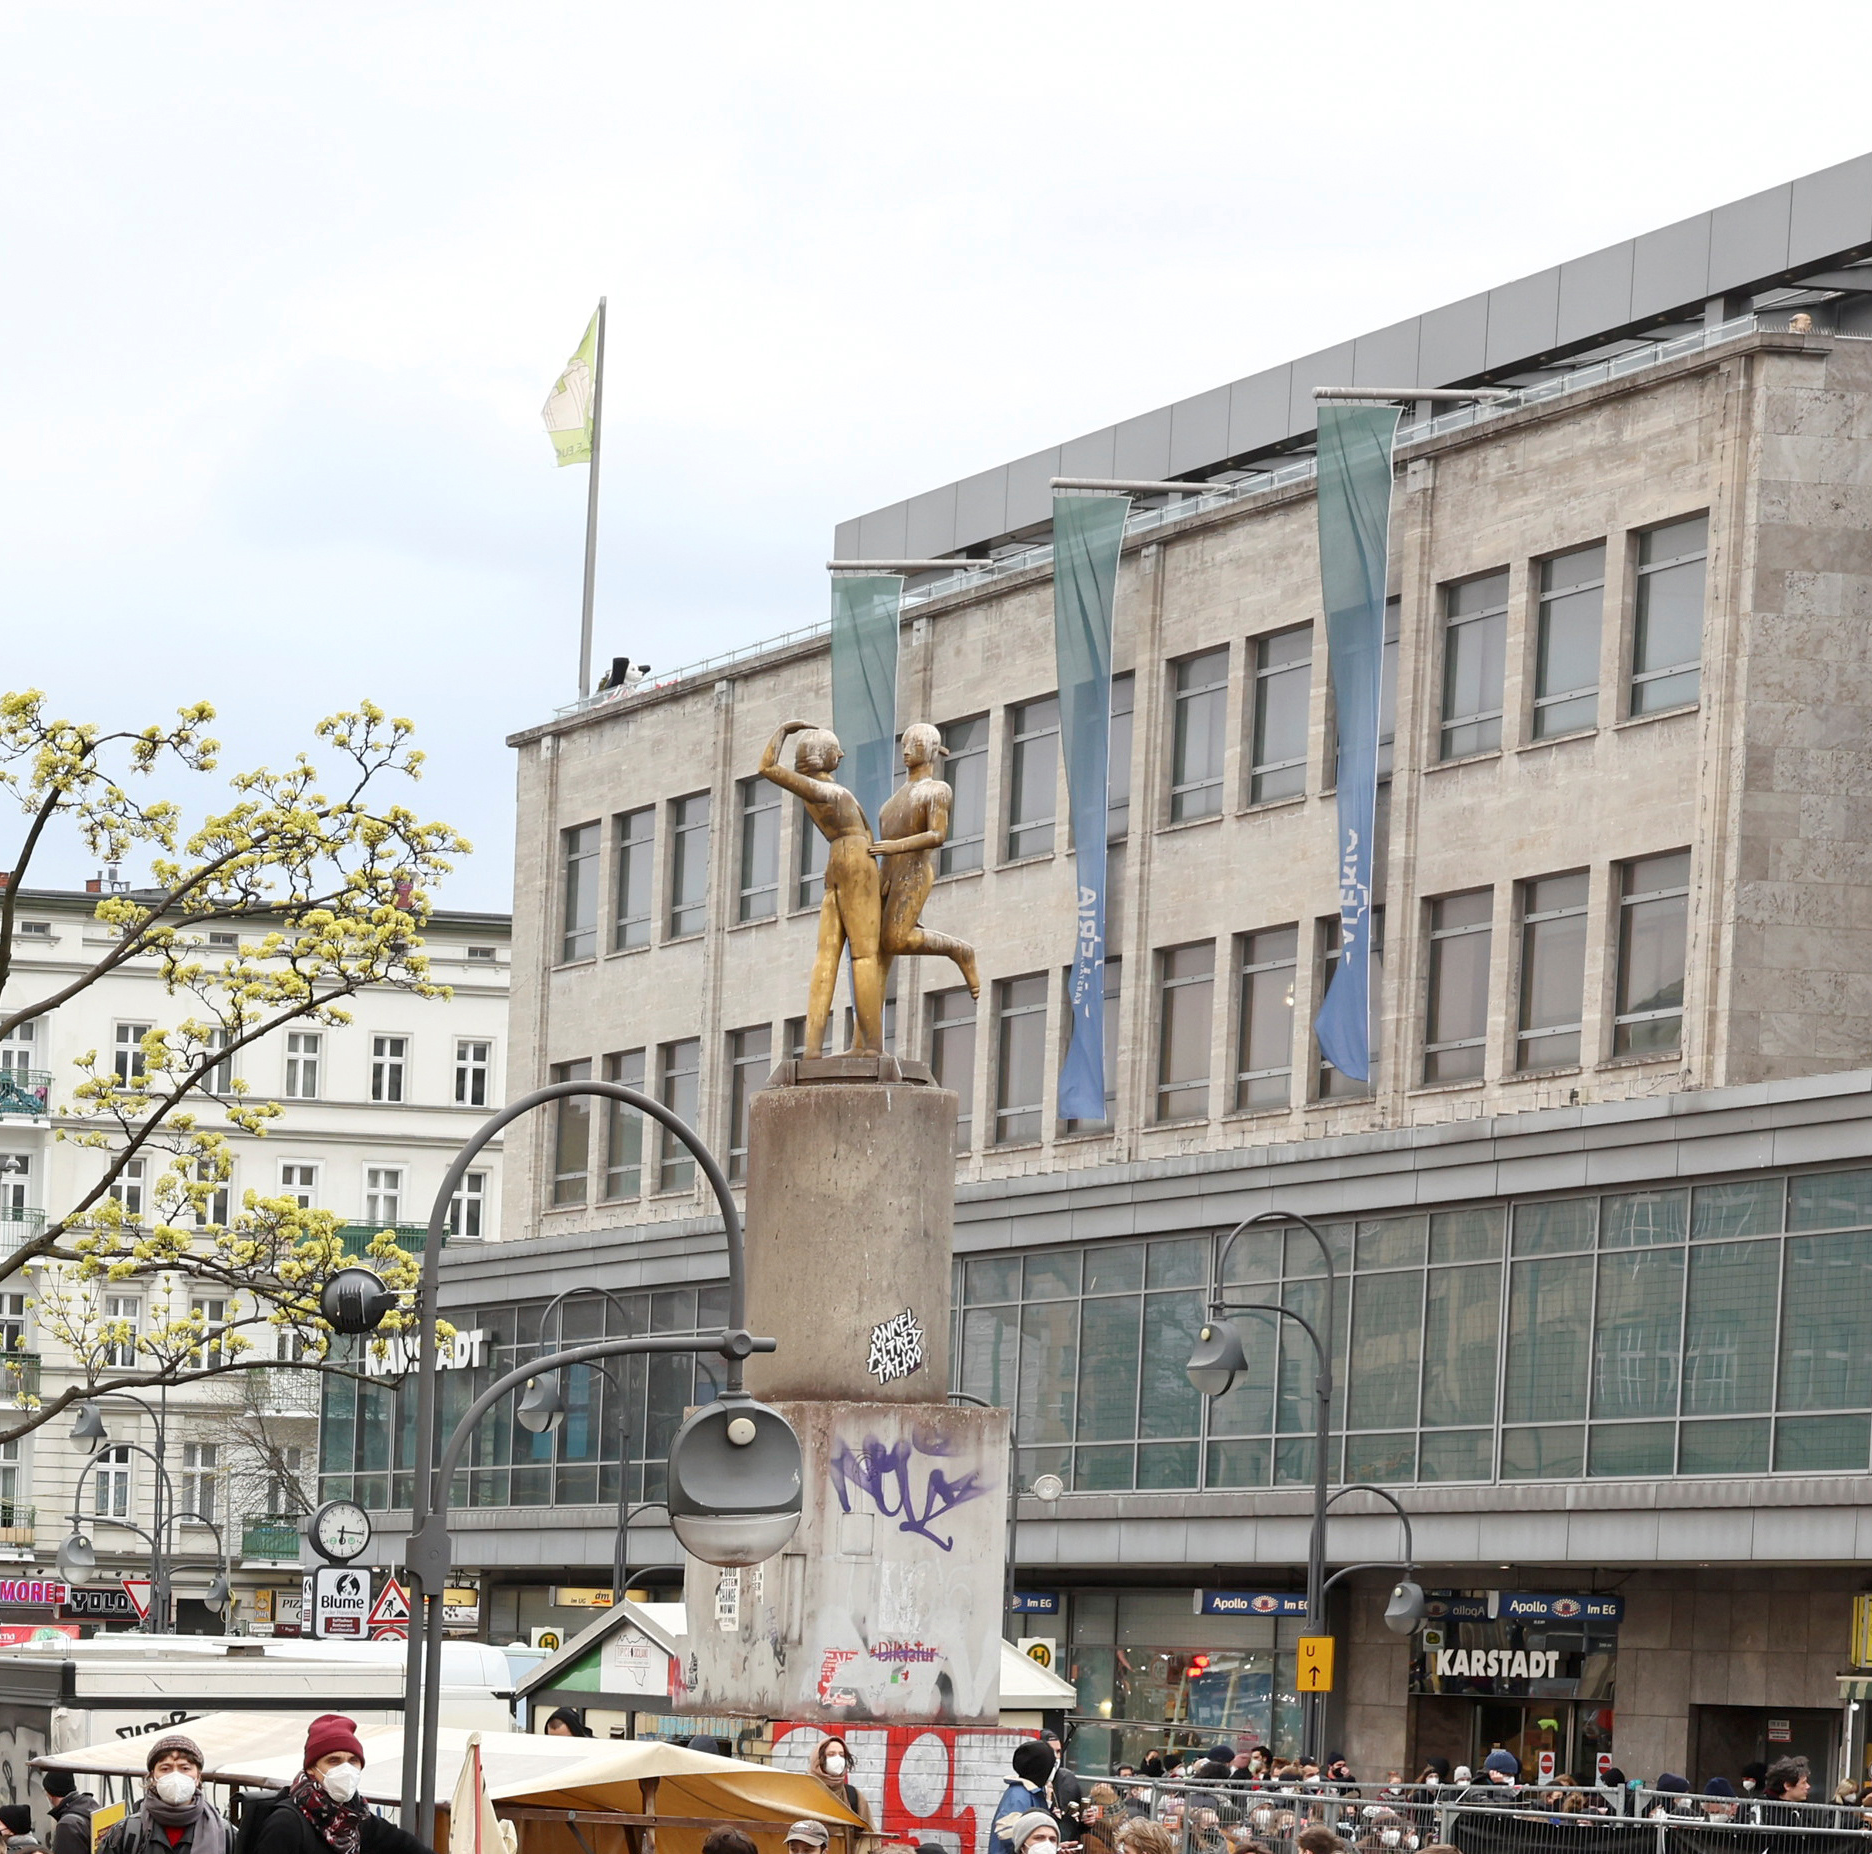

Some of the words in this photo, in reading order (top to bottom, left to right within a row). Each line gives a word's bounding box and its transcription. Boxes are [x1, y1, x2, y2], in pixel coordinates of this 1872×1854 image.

[871, 1307, 918, 1340] ONKEL
[365, 1329, 483, 1377] KARSADT
[320, 1594, 365, 1610] Blume
[595, 1590, 610, 1600] dm
[718, 1604, 737, 1614] NOW!
[1026, 1598, 1039, 1608] Im
[1039, 1599, 1053, 1609] EG
[1213, 1596, 1248, 1611] Apollo
[1284, 1599, 1296, 1610] Im
[1509, 1599, 1548, 1613] Apollo
[1587, 1604, 1601, 1615] Im
[1601, 1604, 1616, 1615] EG
[1306, 1645, 1315, 1657] U
[1436, 1648, 1560, 1679] KARSTADT
